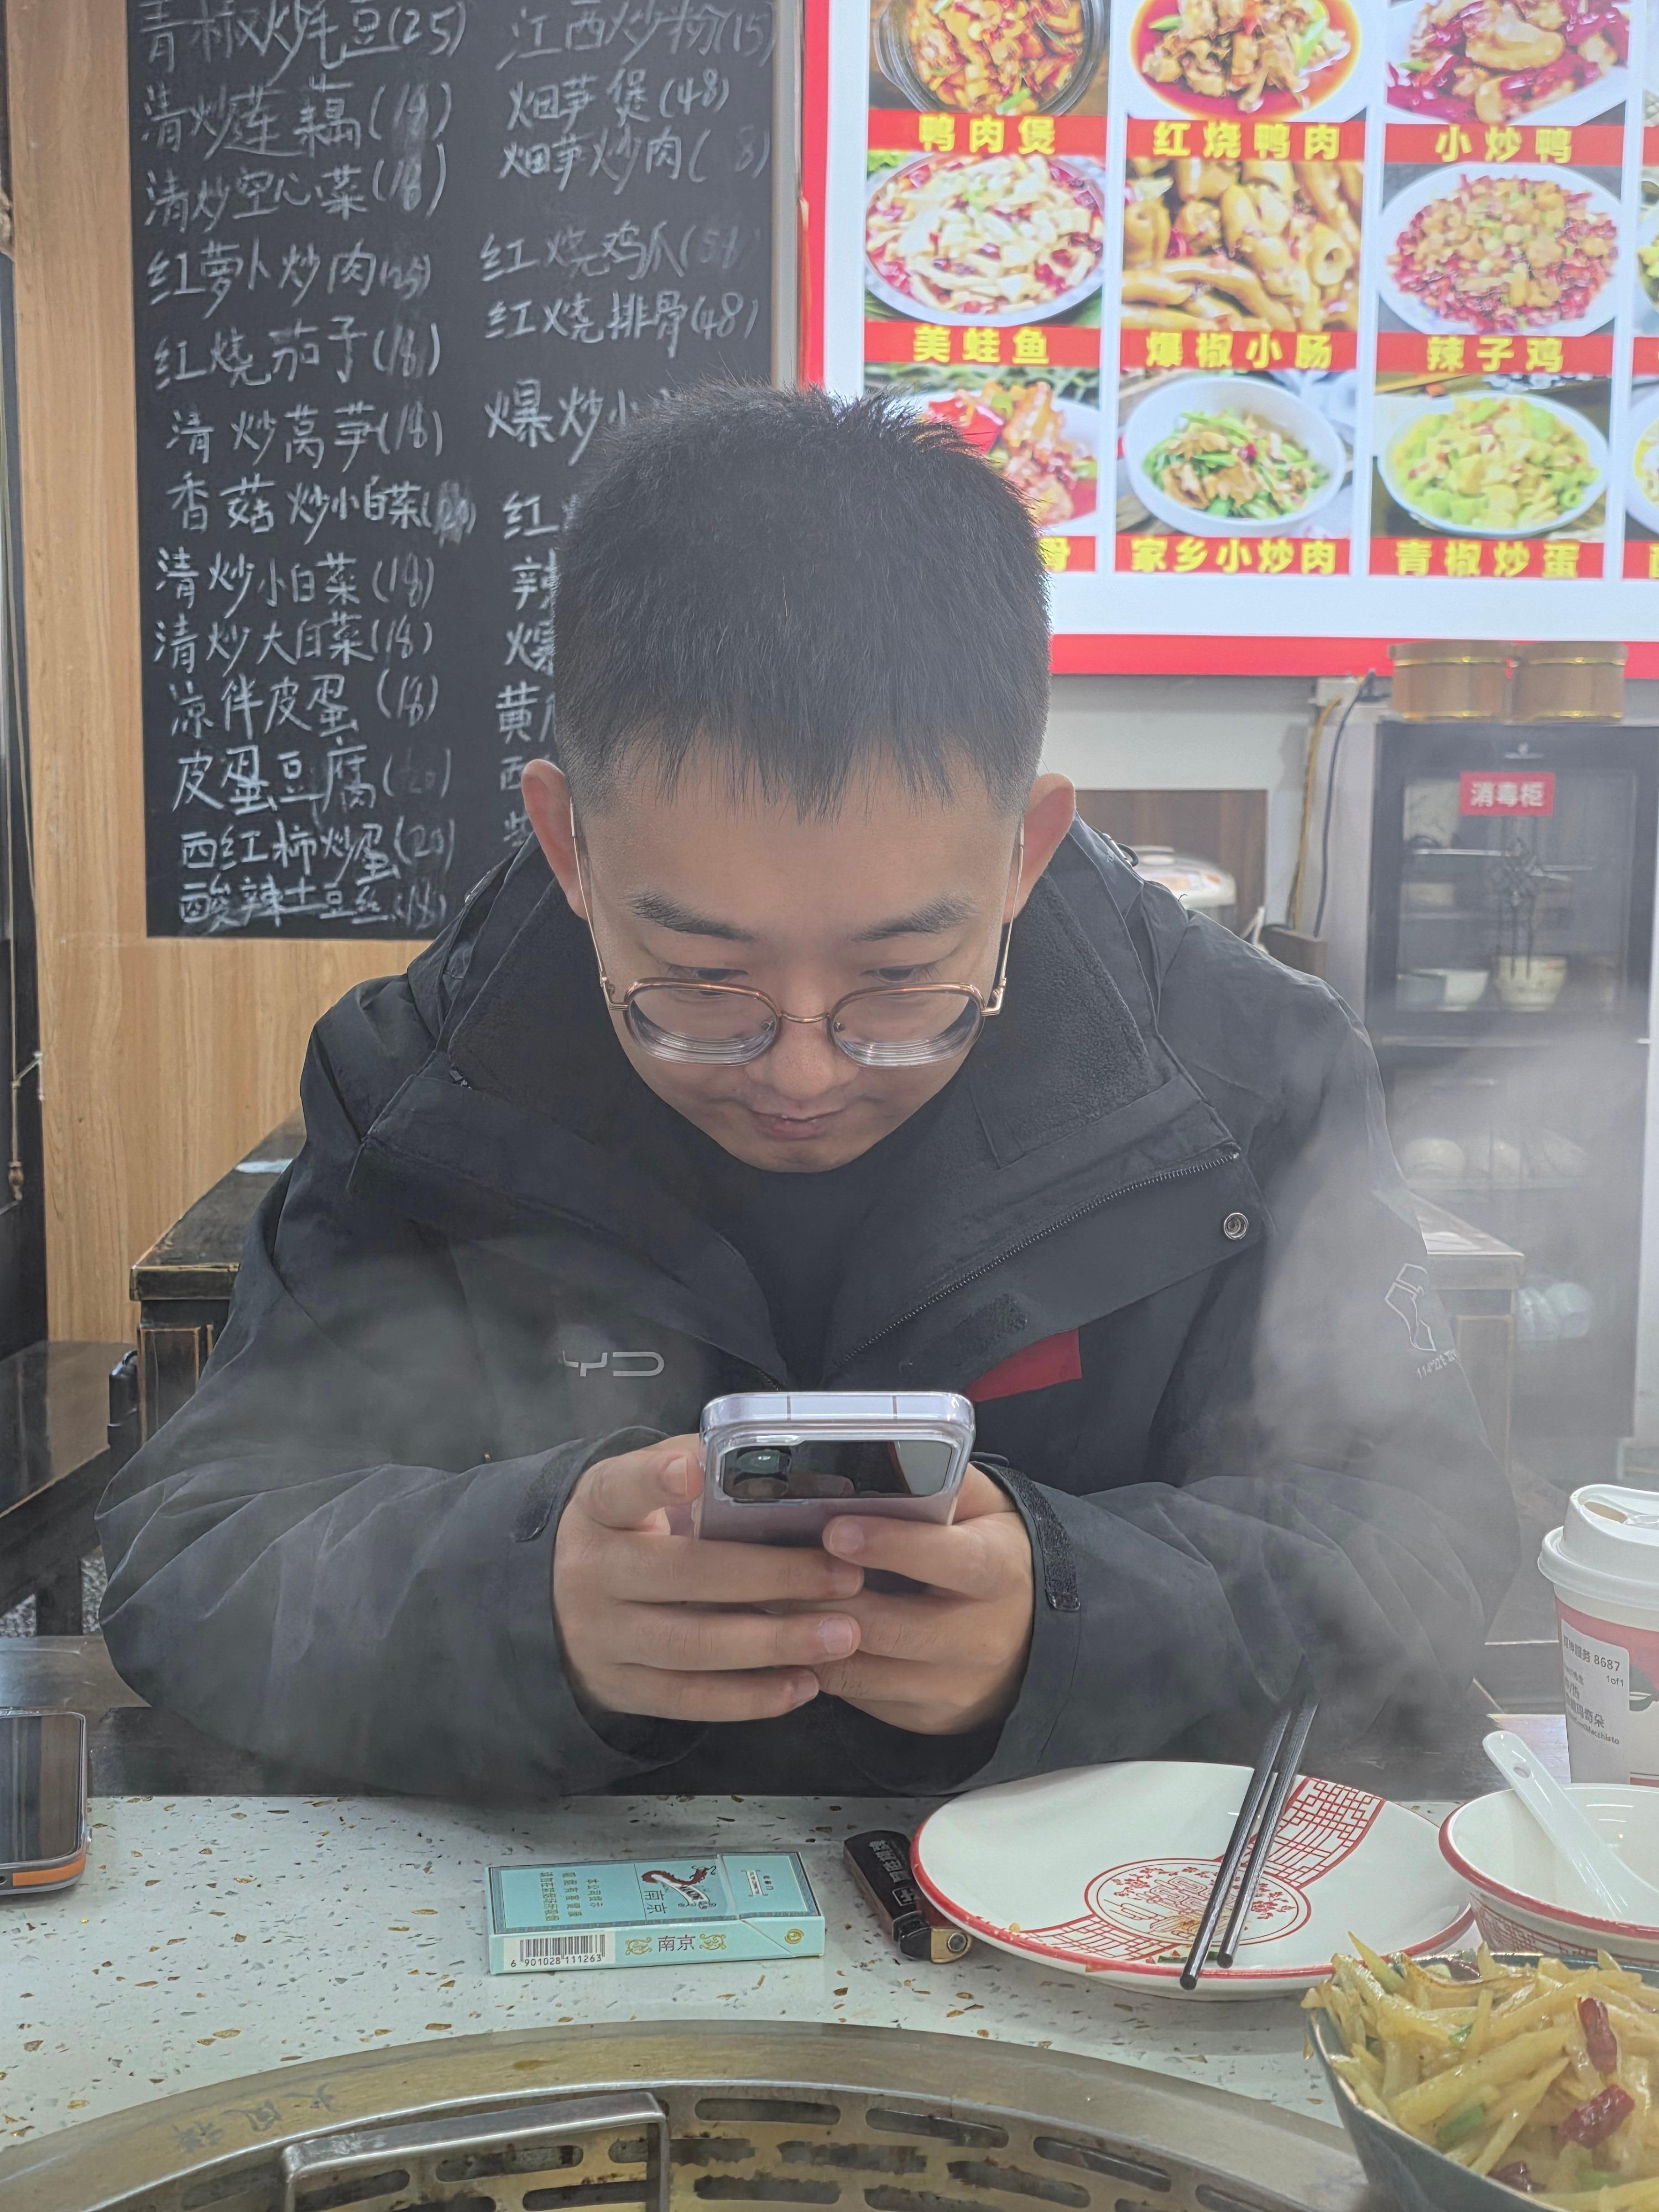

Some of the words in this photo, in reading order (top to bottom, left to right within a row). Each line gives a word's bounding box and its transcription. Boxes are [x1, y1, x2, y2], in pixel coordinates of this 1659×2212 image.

[919, 115, 1055, 154] 鸭肉煲
[1152, 121, 1340, 160] 红烧鸭肉
[1436, 124, 1572, 163] 小炒鸭
[913, 325, 1049, 363] 美蛙鱼
[1146, 330, 1332, 369] 爆椒小肠
[1427, 336, 1563, 372] 辣子鸡
[1131, 537, 1337, 575] 家乡小炒肉
[1396, 540, 1580, 578] 青椒炒蛋
[1470, 780, 1545, 807] 消毒柜
[1594, 1655, 1620, 1672] 8687
[644, 1890, 668, 1914] 南京
[658, 1936, 696, 1952] 南京
